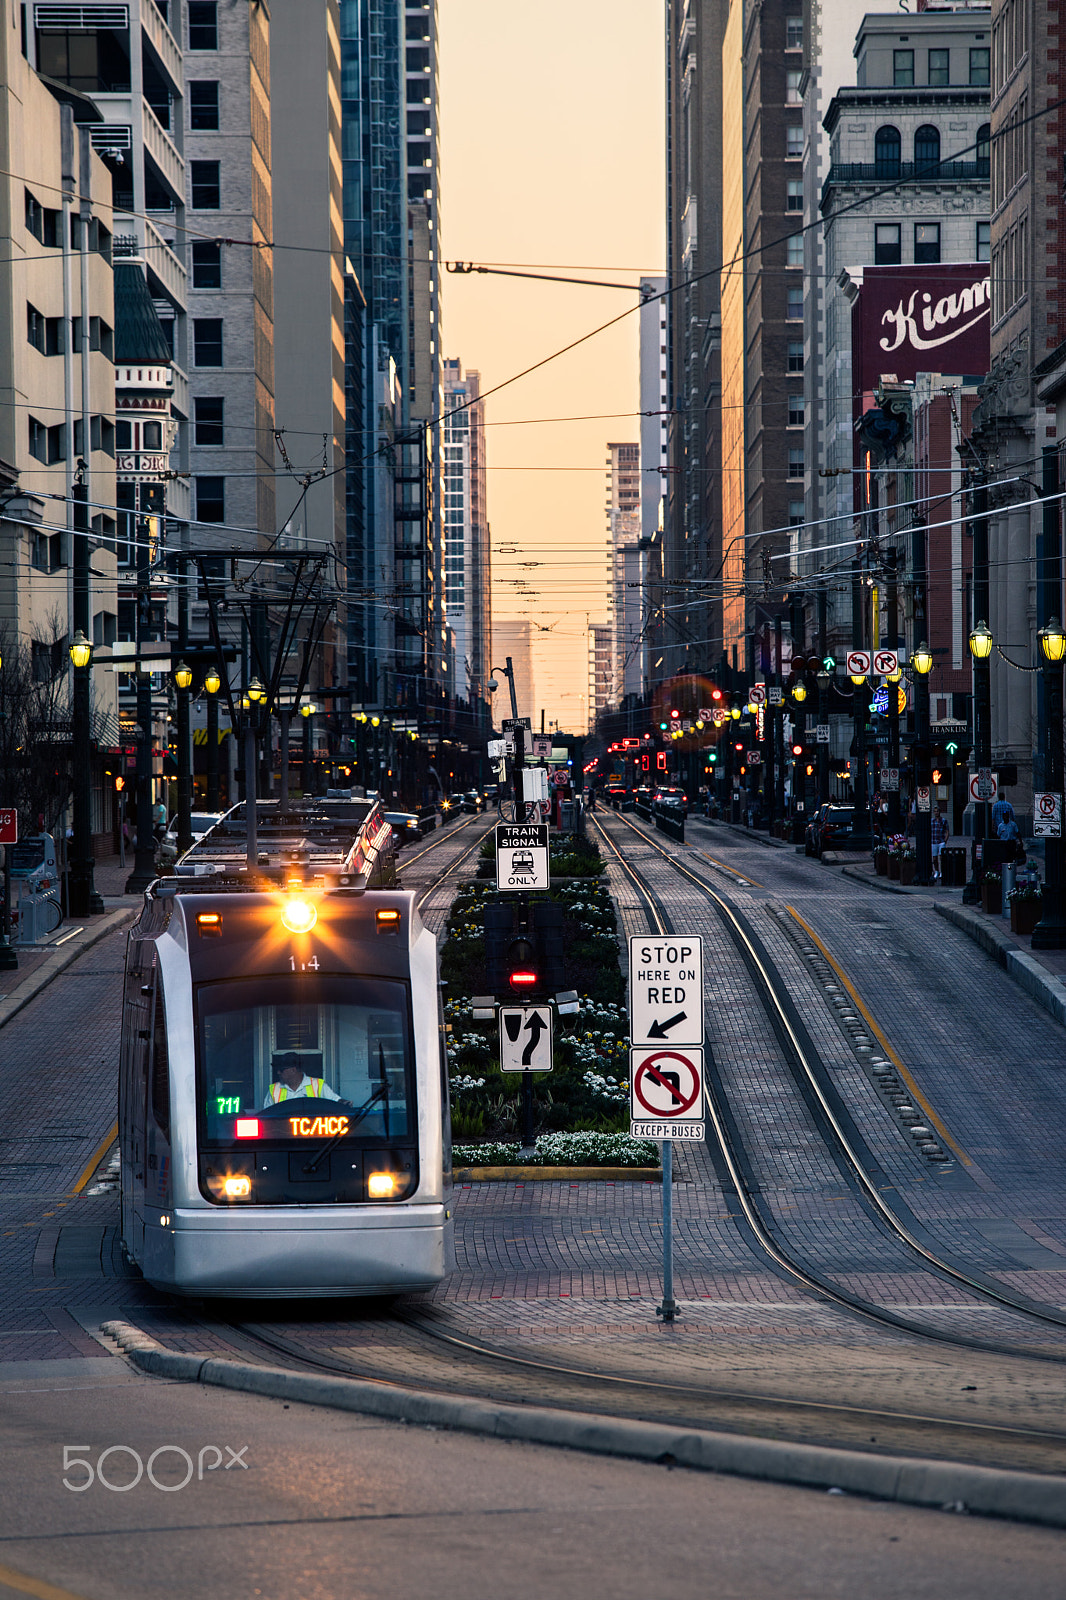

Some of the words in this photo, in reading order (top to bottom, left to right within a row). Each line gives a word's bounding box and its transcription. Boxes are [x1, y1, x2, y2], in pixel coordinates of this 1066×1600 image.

[505, 827, 539, 836] TRAIN
[501, 838, 543, 847] SIGNAL
[507, 876, 538, 885] ONLY
[641, 947, 692, 964] STOP
[637, 970, 671, 981] HERE
[678, 970, 695, 981] ON
[648, 987, 686, 1004] RED
[217, 1097, 240, 1114] 711
[289, 1117, 349, 1136] TC/HCC
[634, 1124, 667, 1136] EXCEPT
[671, 1126, 701, 1137] BUSES
